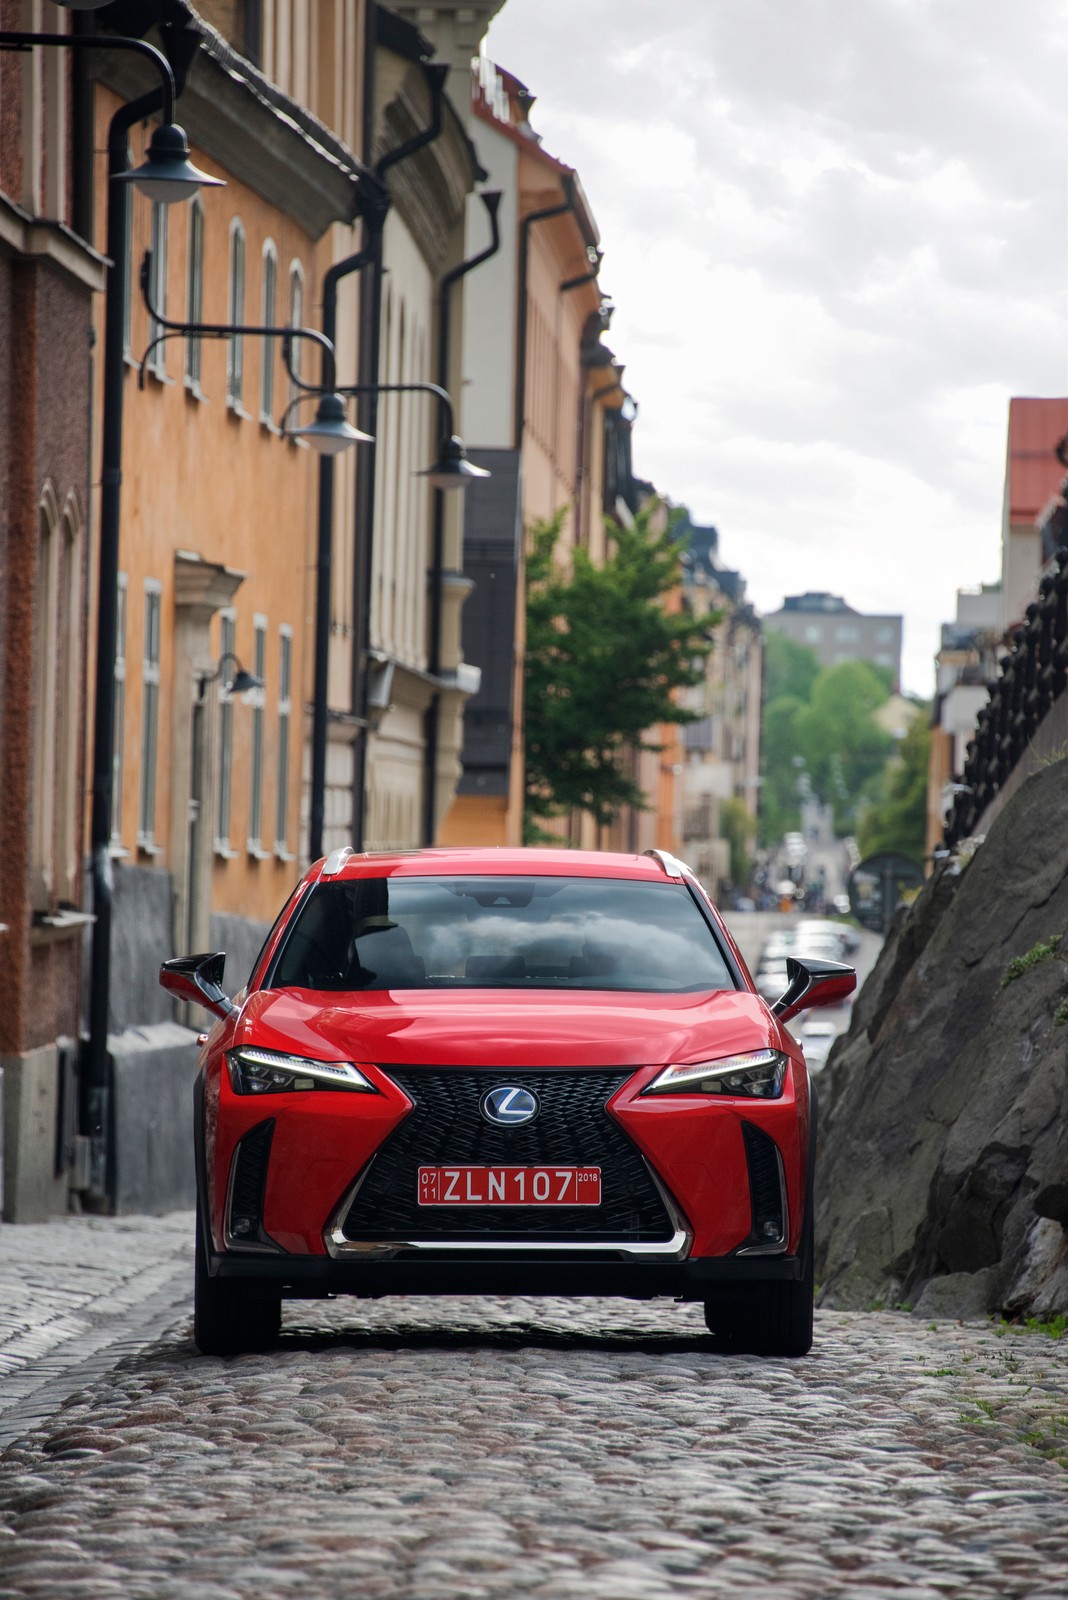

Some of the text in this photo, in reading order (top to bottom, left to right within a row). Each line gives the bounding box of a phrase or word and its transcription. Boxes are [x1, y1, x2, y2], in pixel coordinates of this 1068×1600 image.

[421, 1173, 437, 1185] 07
[578, 1173, 598, 1182] 2018
[443, 1171, 573, 1201] ZLN107
[422, 1187, 437, 1199] 11
